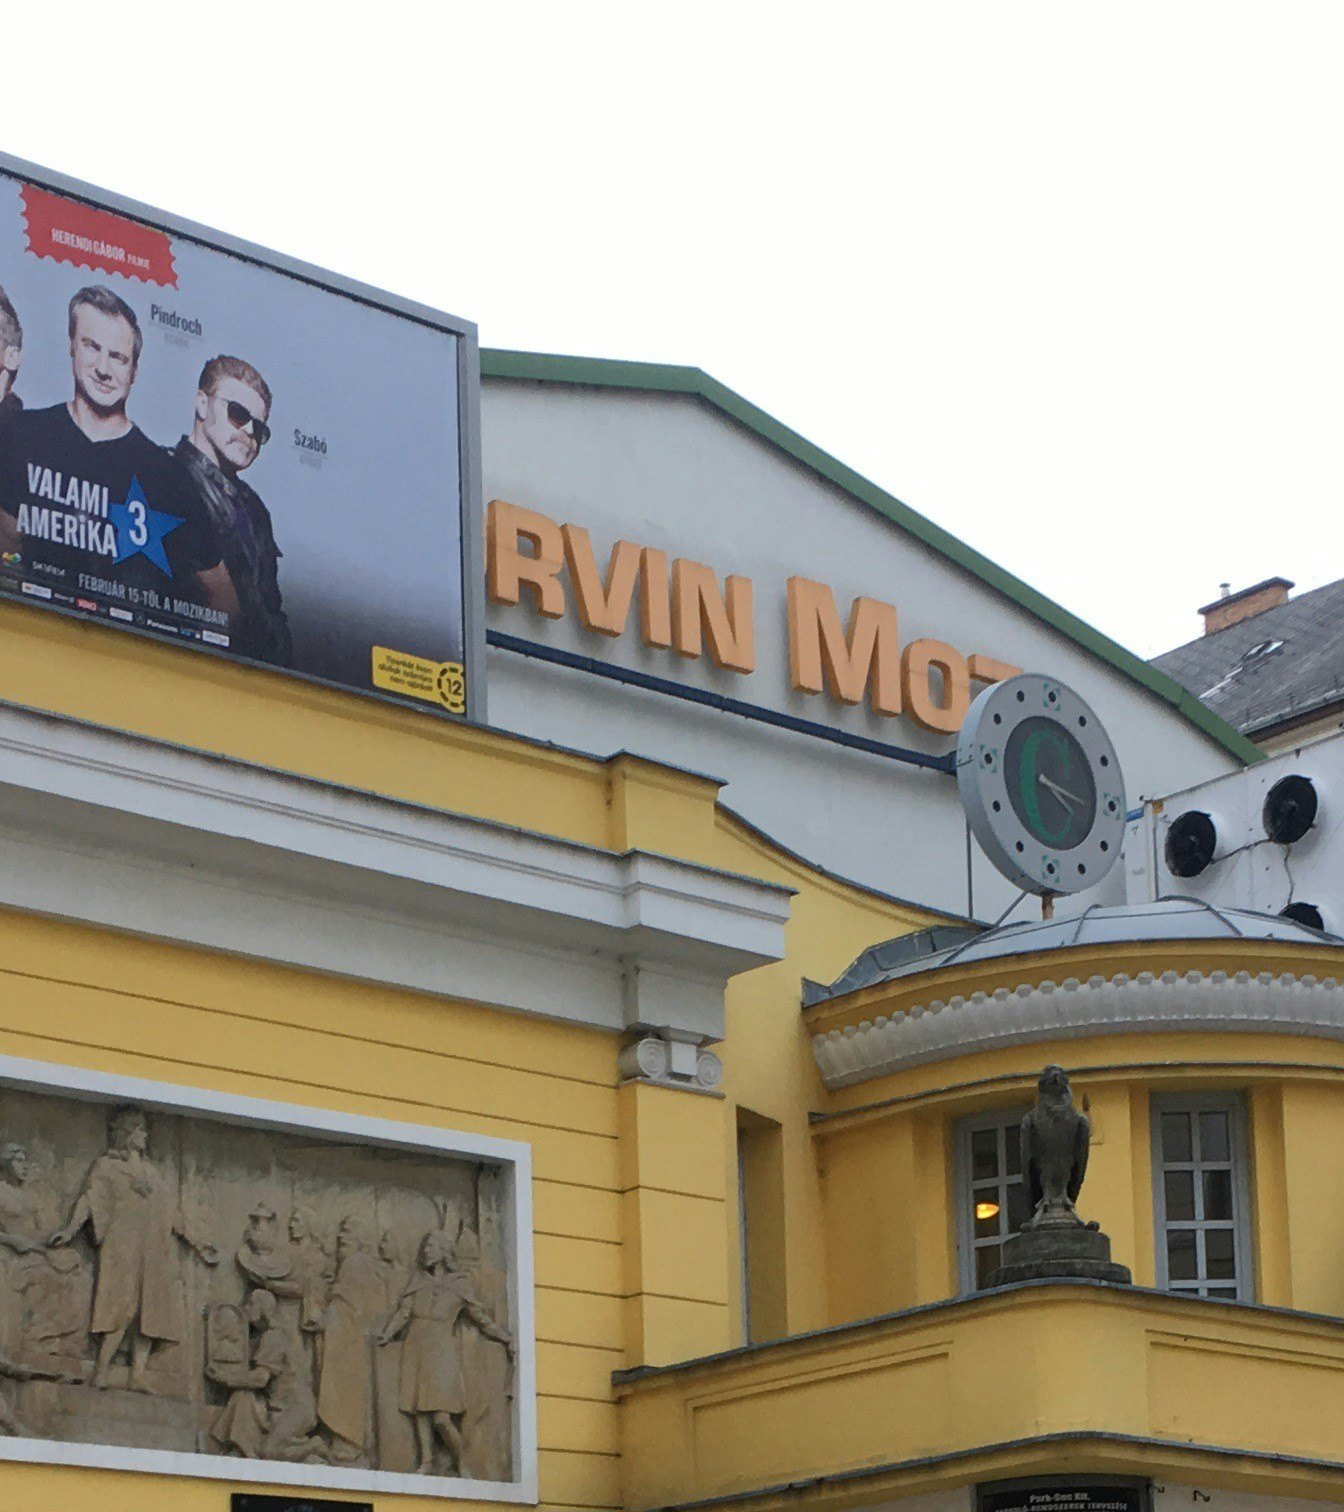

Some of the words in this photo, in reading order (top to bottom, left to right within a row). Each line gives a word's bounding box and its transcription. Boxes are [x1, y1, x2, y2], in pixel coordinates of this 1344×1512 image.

[151, 303, 202, 336] Pindroch
[294, 428, 327, 454] Szabó
[27, 462, 109, 519] VALAMI
[128, 500, 148, 547] 3
[485, 499, 755, 675] RVIN
[446, 678, 463, 697] 12
